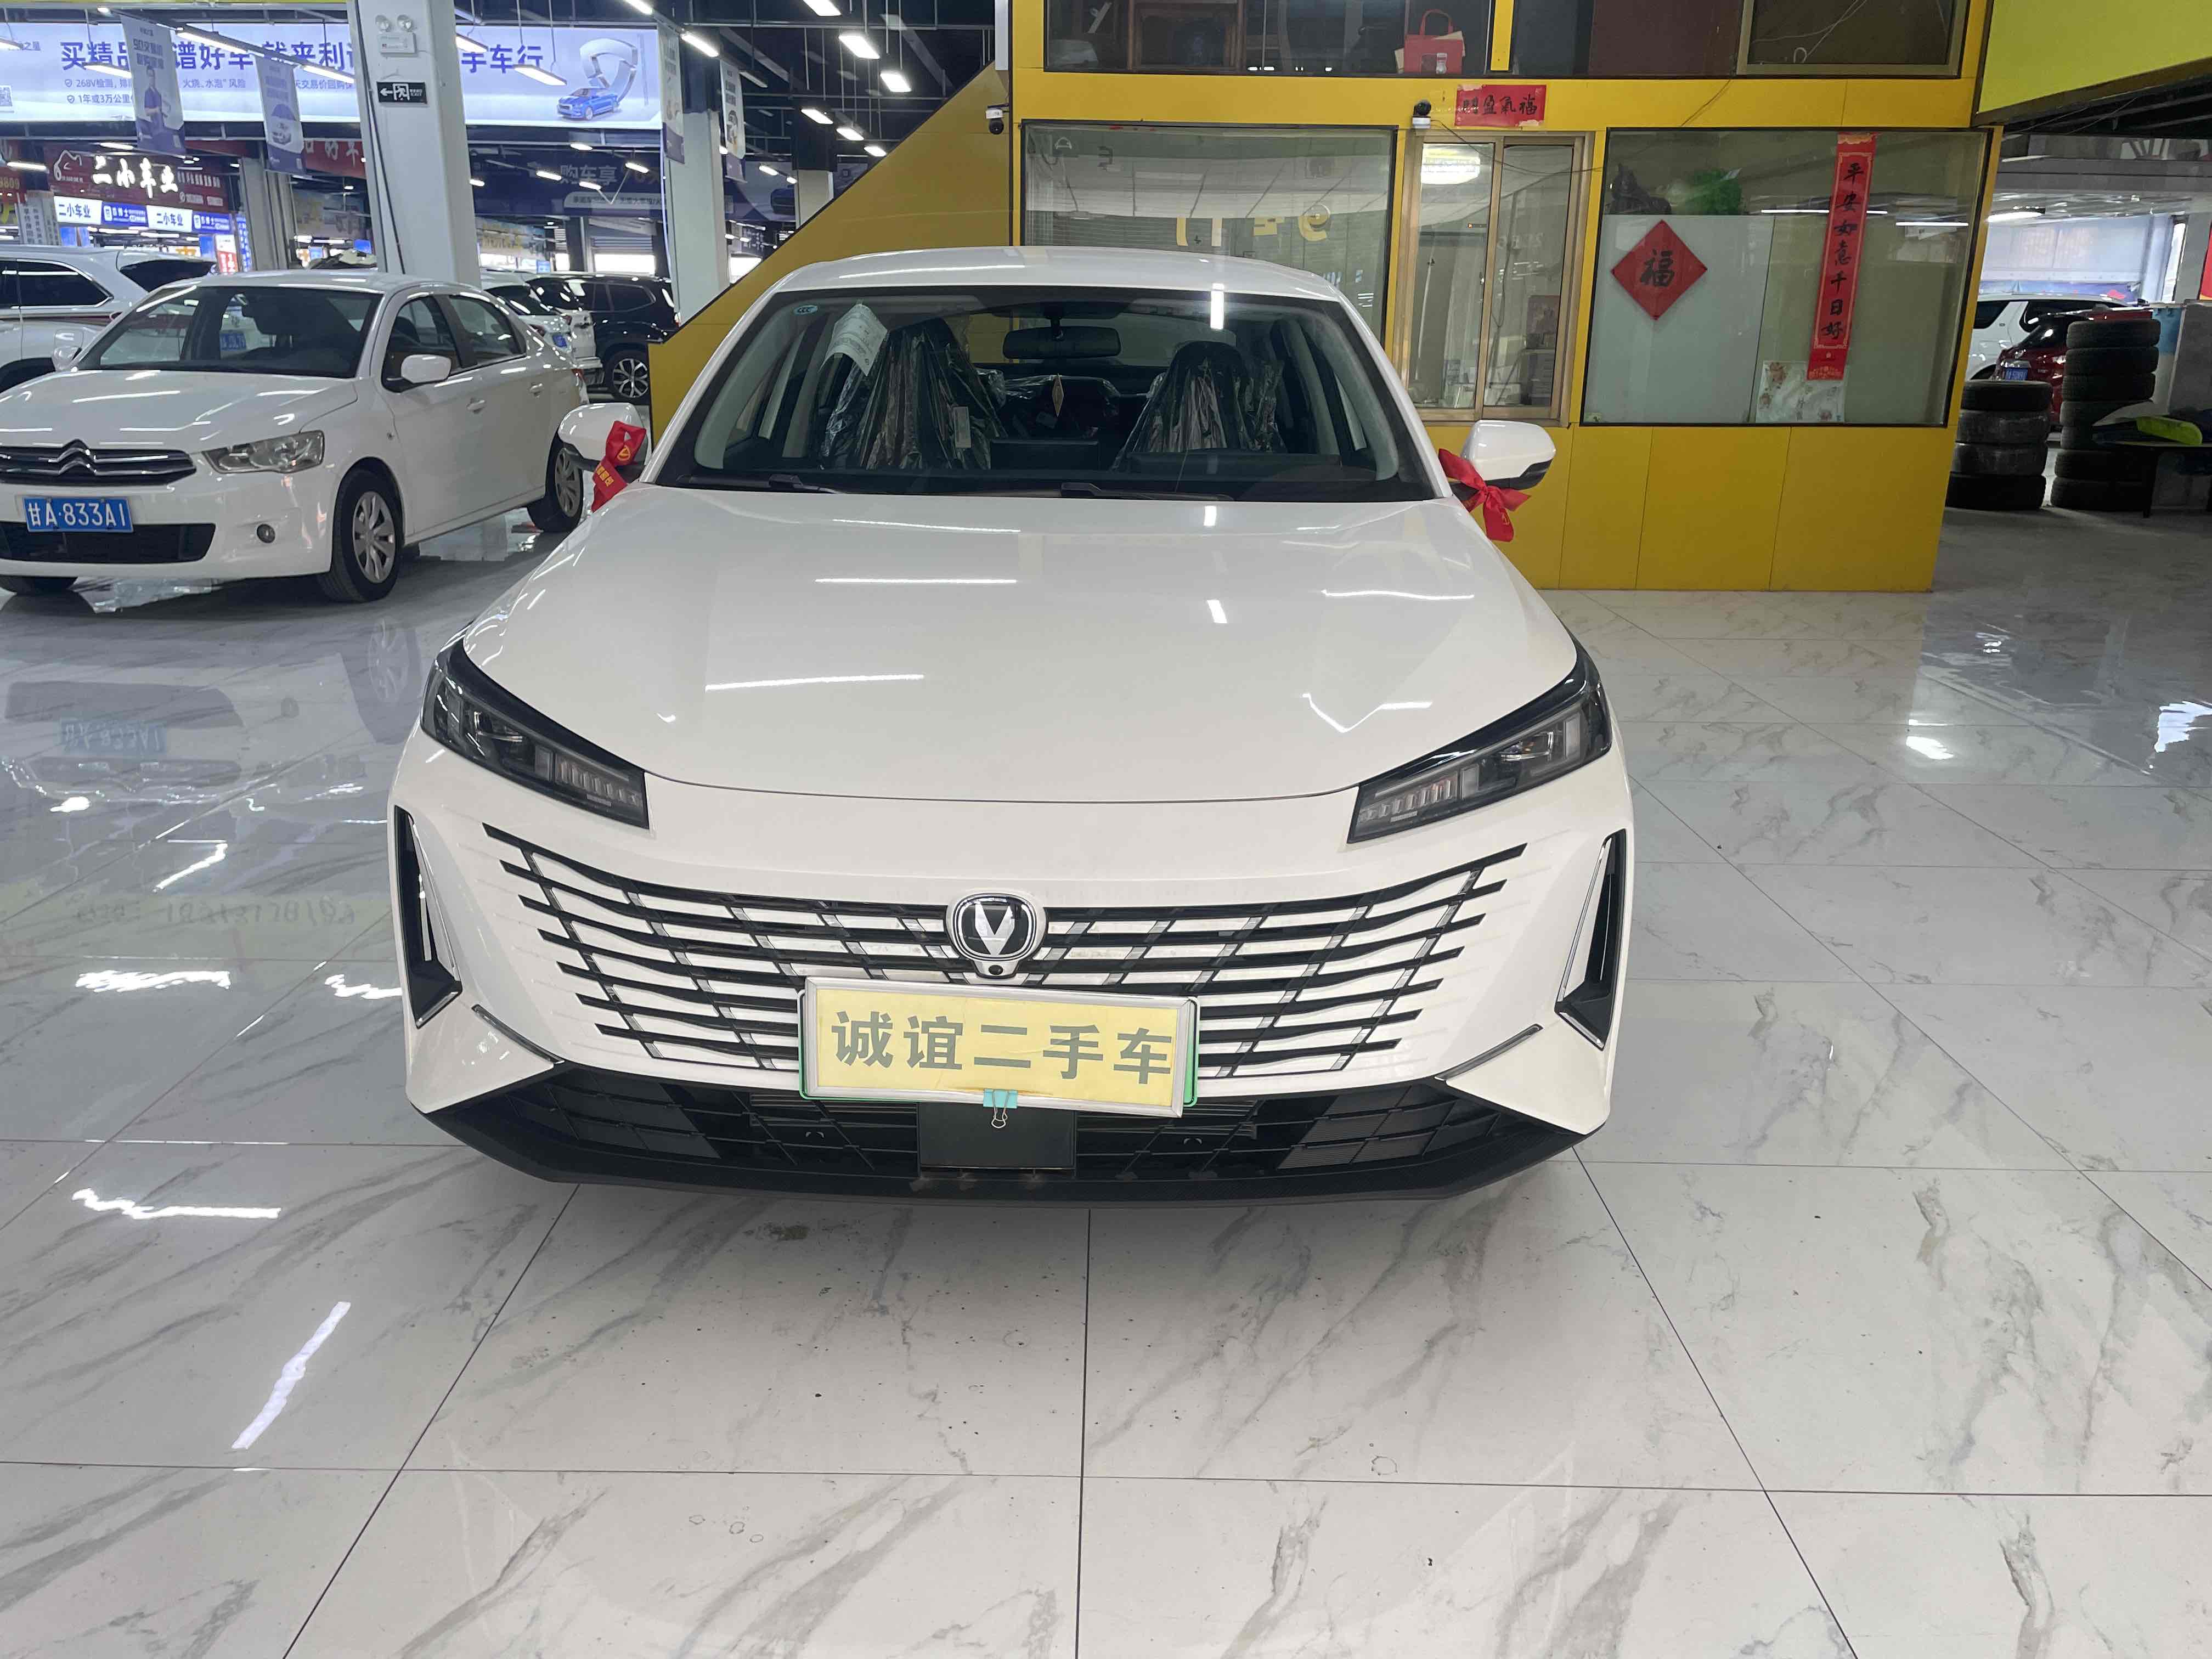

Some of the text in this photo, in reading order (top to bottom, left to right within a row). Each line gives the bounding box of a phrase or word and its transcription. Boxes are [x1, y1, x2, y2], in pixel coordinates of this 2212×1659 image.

[58, 204, 91, 219] 二小车业
[1640, 248, 1675, 287] 福
[1821, 162, 1864, 340] 平安如意千日好
[831, 1010, 1172, 1085] 诚谊二手车
